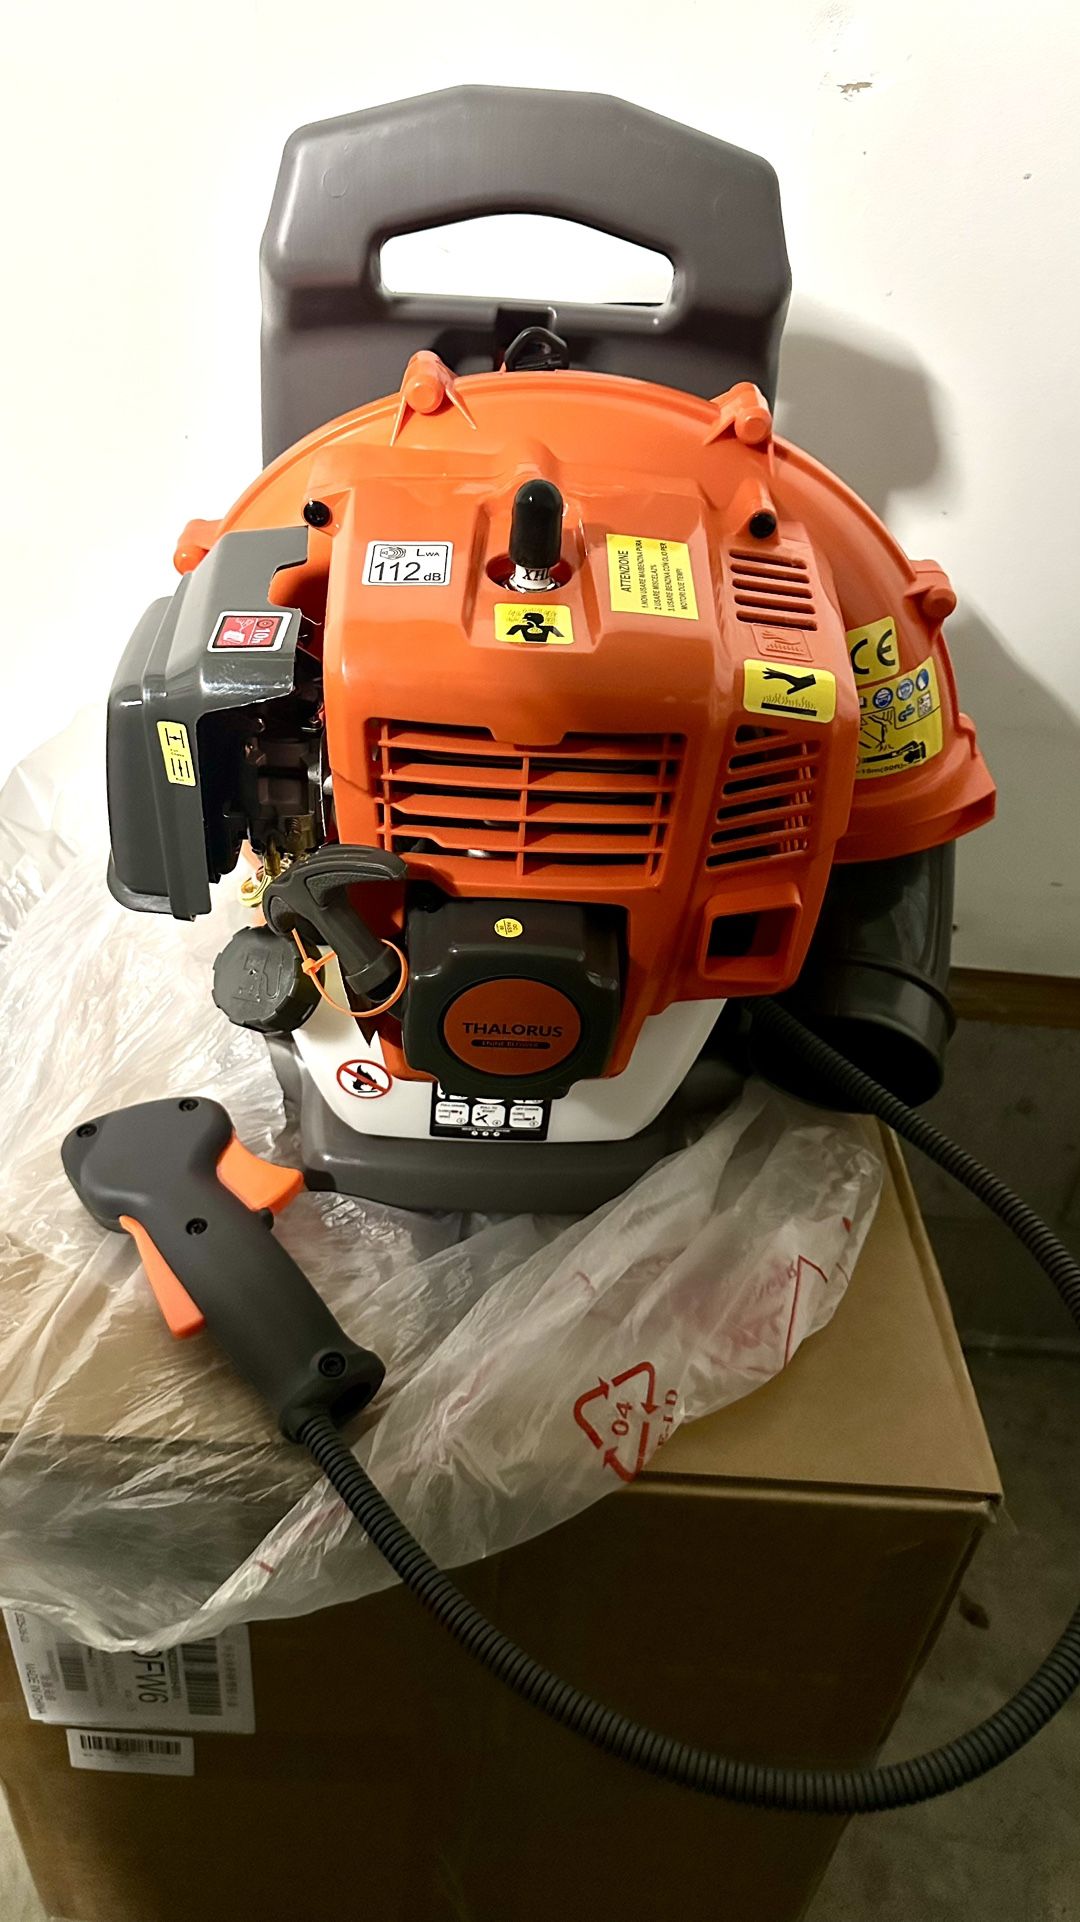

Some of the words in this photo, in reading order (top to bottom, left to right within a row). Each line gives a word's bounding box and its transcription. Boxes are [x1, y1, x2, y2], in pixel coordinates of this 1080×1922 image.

[374, 561, 421, 581] 112
[423, 572, 442, 581] dB
[618, 550, 631, 593] ATTENZIONE
[462, 1022, 563, 1038] THALORUS
[612, 1402, 632, 1436] 04
